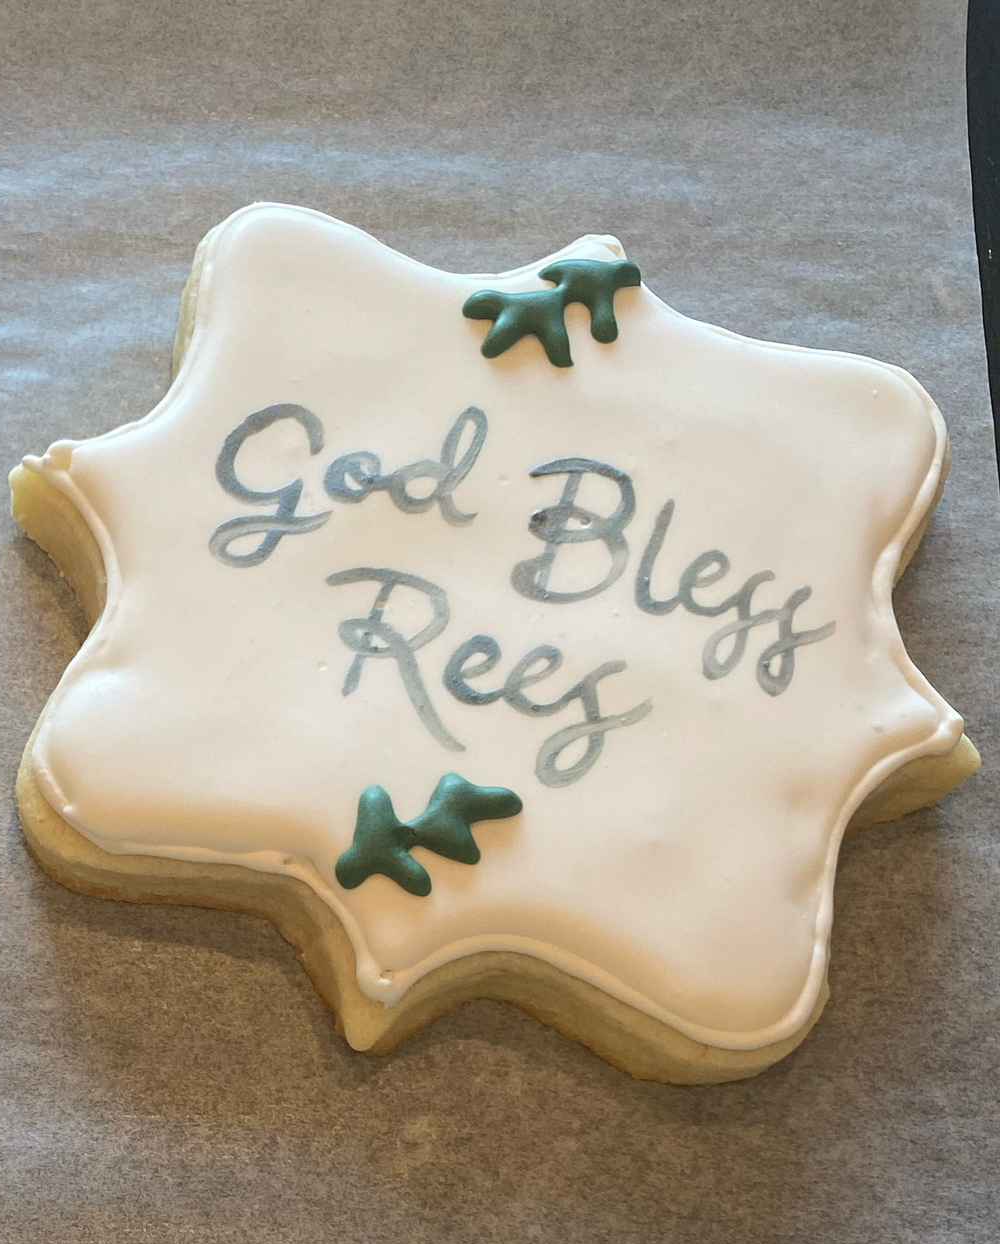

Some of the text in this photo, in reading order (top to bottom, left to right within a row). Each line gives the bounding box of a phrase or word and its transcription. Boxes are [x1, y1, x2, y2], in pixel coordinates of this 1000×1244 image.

[207, 403, 836, 697] God Bless
[326, 566, 653, 788] Rees
